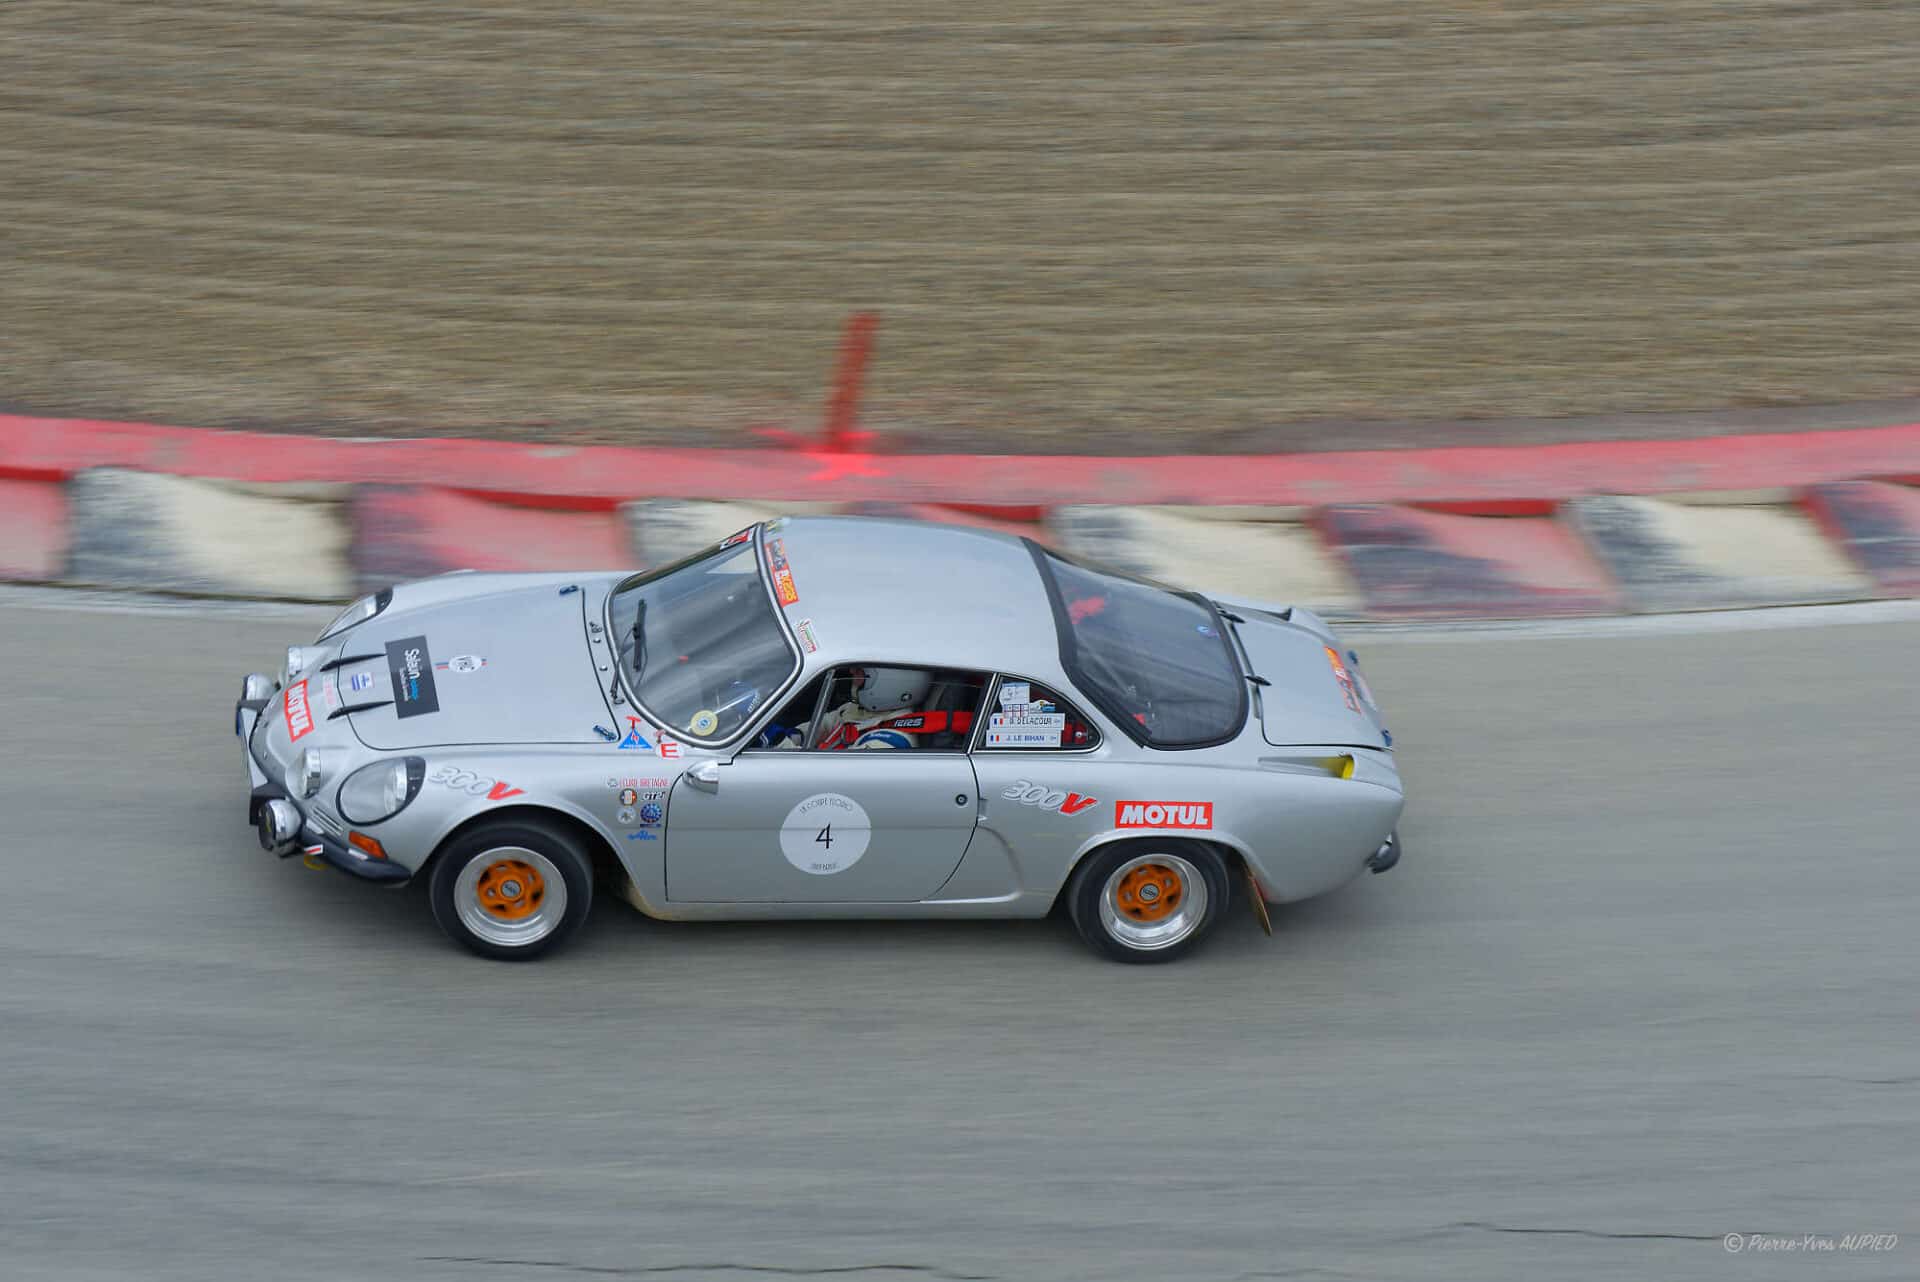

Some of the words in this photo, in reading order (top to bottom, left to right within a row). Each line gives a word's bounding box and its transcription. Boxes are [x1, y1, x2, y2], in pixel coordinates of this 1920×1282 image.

[287, 680, 310, 737] MOTUL
[660, 743, 680, 758] E
[429, 766, 525, 800] 300V
[1001, 779, 1097, 815] 300V
[1120, 804, 1208, 825] MOTUL
[815, 821, 833, 849] 4
